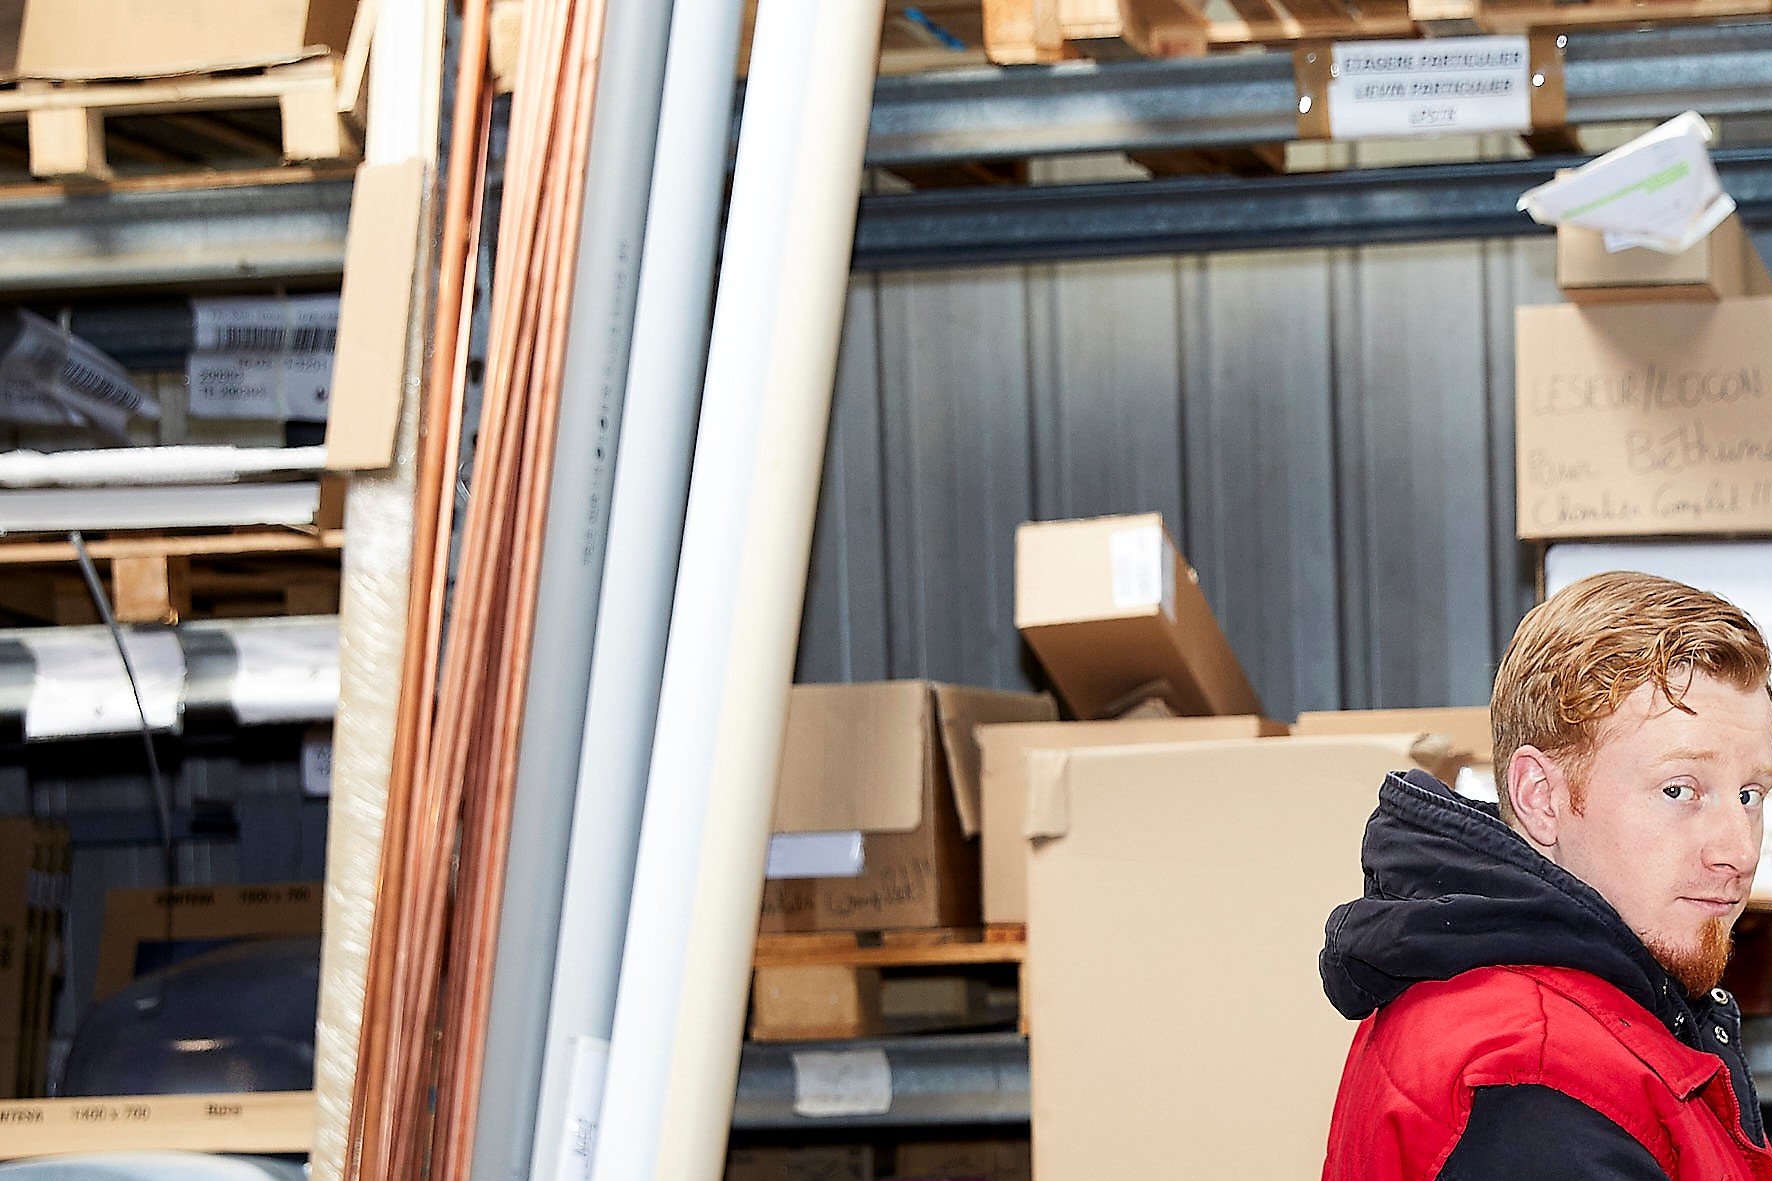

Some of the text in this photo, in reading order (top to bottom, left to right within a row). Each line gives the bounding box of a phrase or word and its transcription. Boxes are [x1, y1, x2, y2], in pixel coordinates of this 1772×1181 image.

[1421, 51, 1521, 69] PARTICULIER
[1354, 79, 1512, 99] LIEVIN PARTICULIER
